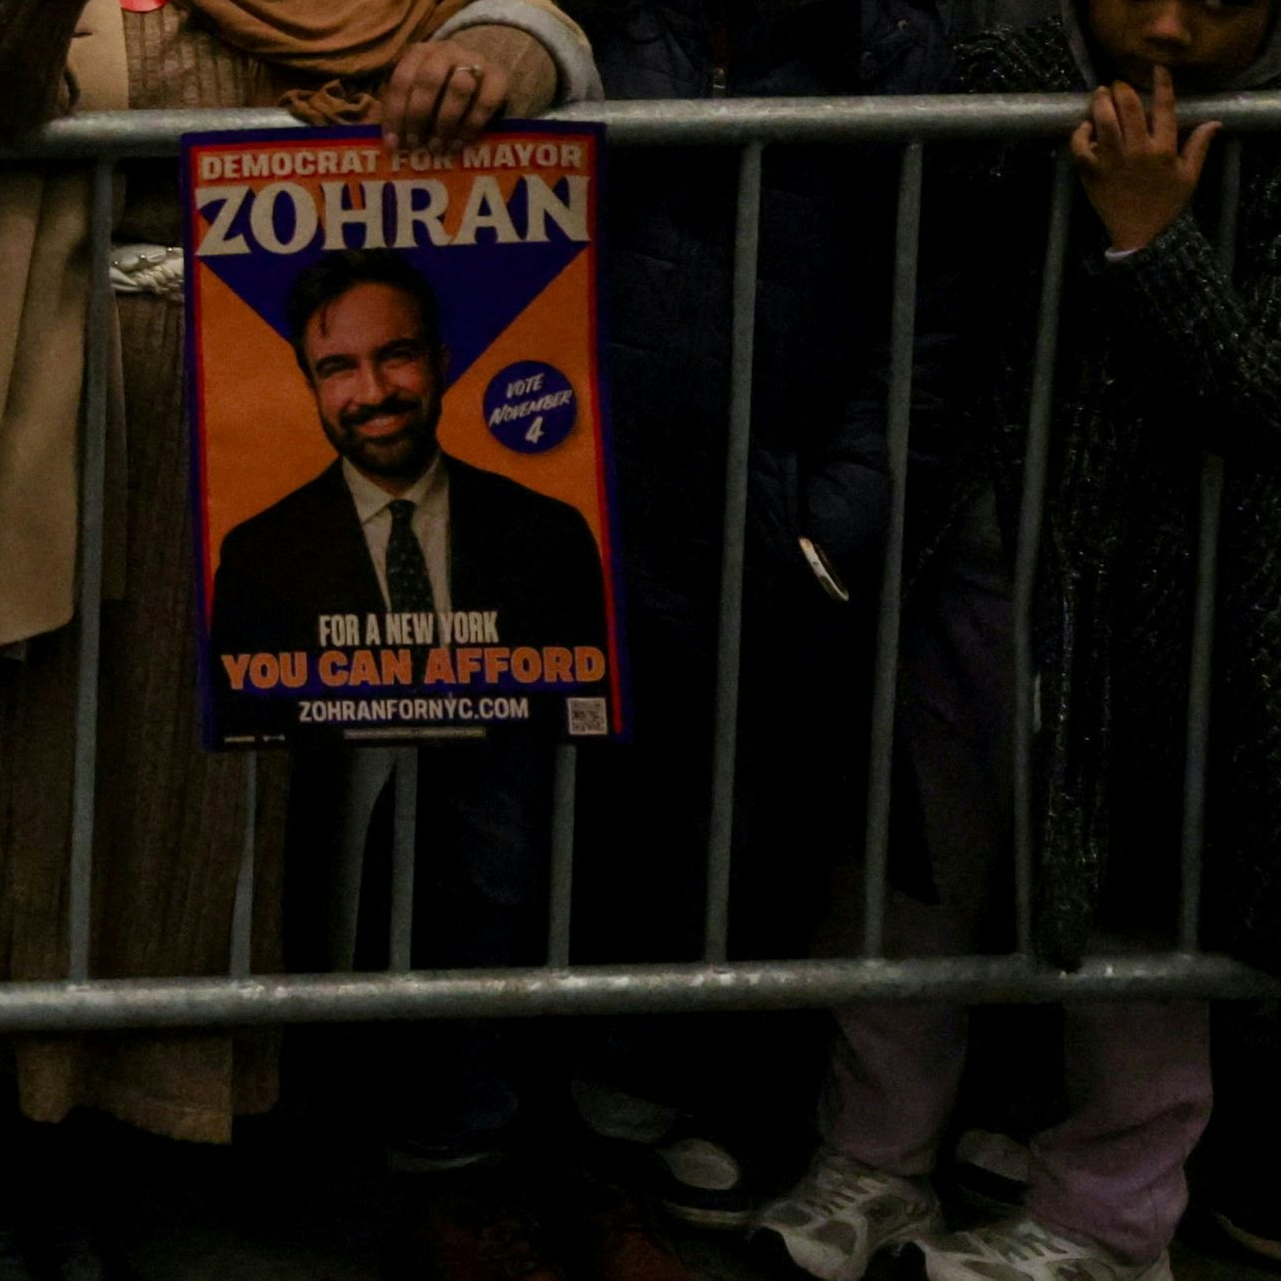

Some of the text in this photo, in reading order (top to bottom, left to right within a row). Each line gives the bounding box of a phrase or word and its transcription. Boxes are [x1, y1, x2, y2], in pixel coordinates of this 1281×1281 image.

[201, 150, 380, 180] DEMOCRAT
[463, 144, 583, 170] MAYOR
[195, 176, 592, 256] ZOHRAN
[507, 373, 544, 399] VOTE
[489, 389, 573, 428] NOVEMBER
[525, 416, 544, 444] 4
[319, 612, 499, 647] FOR A NEW YORK
[221, 646, 606, 690] YOU CAN AFFORD
[299, 697, 529, 723] ZOHRANFORNYC.COM
